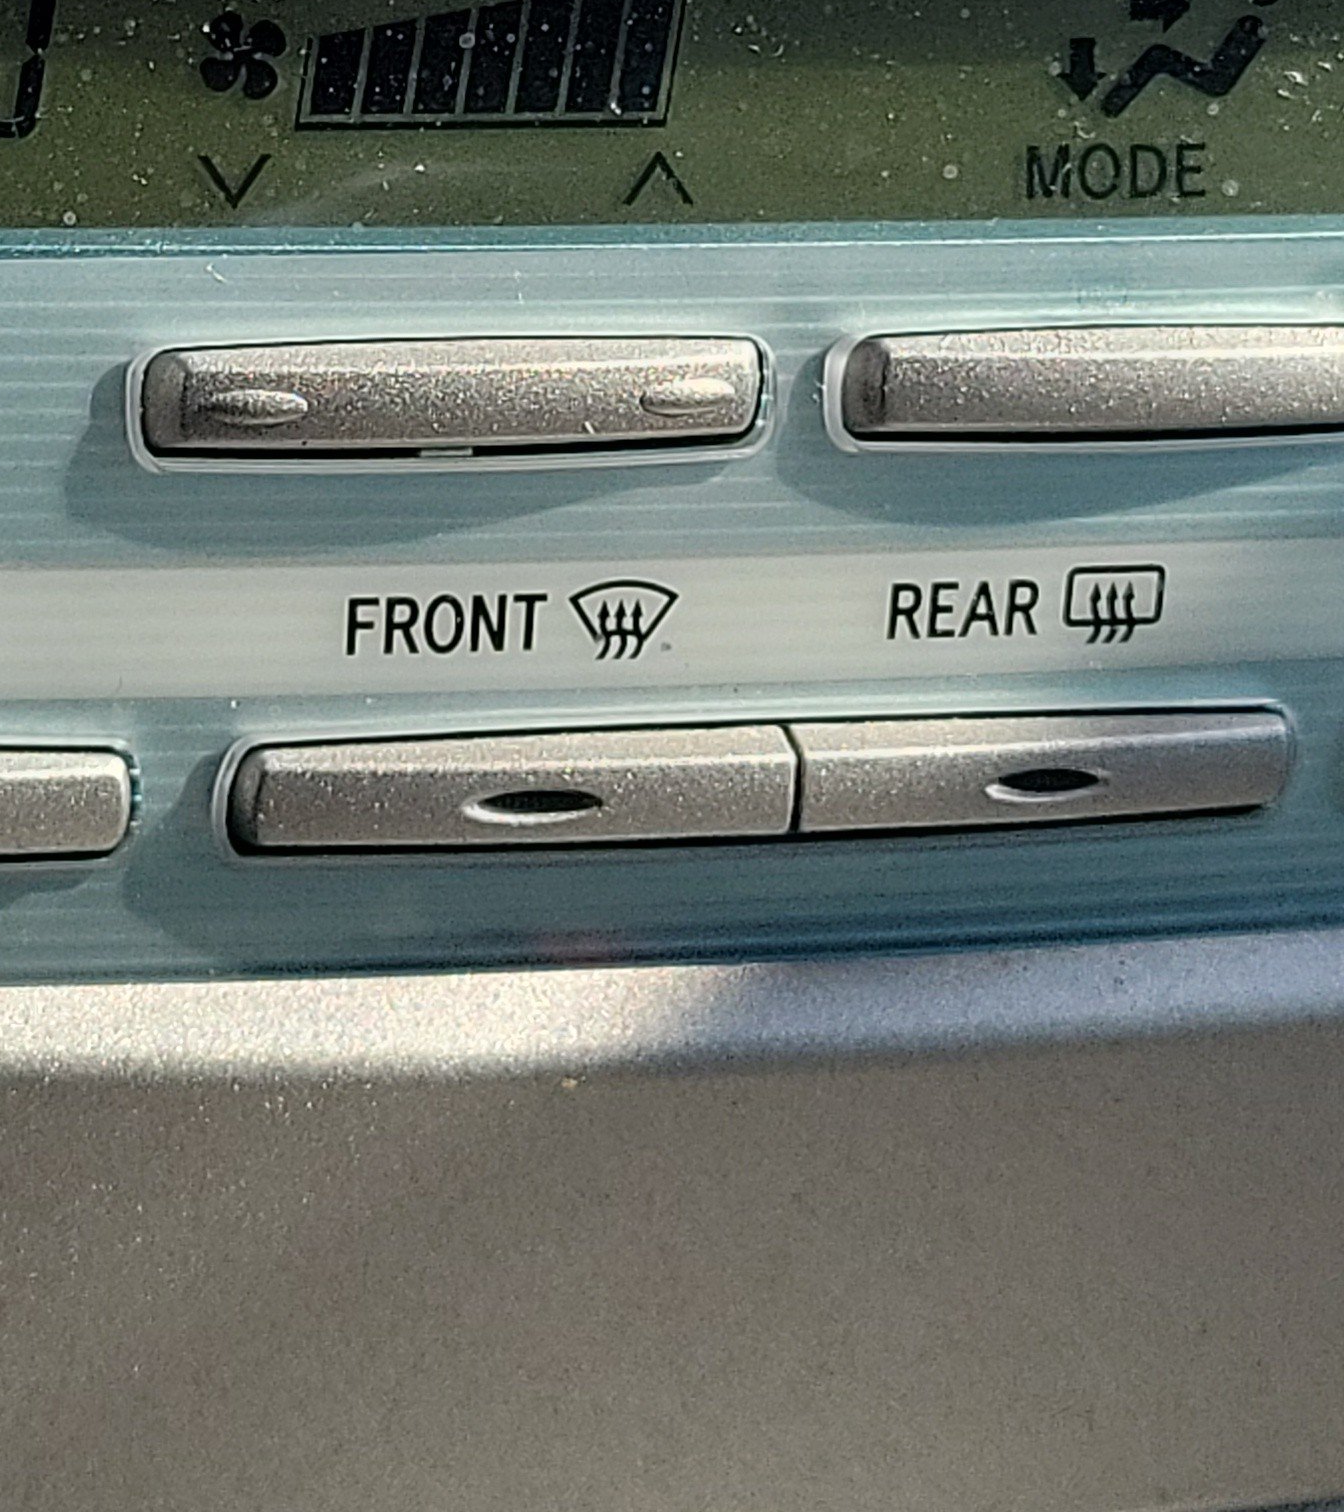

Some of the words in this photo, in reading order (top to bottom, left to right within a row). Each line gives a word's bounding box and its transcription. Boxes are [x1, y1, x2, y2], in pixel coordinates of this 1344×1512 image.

[1024, 140, 1209, 201] MODE
[344, 592, 549, 657] FRONT
[885, 579, 1042, 641] REAR
